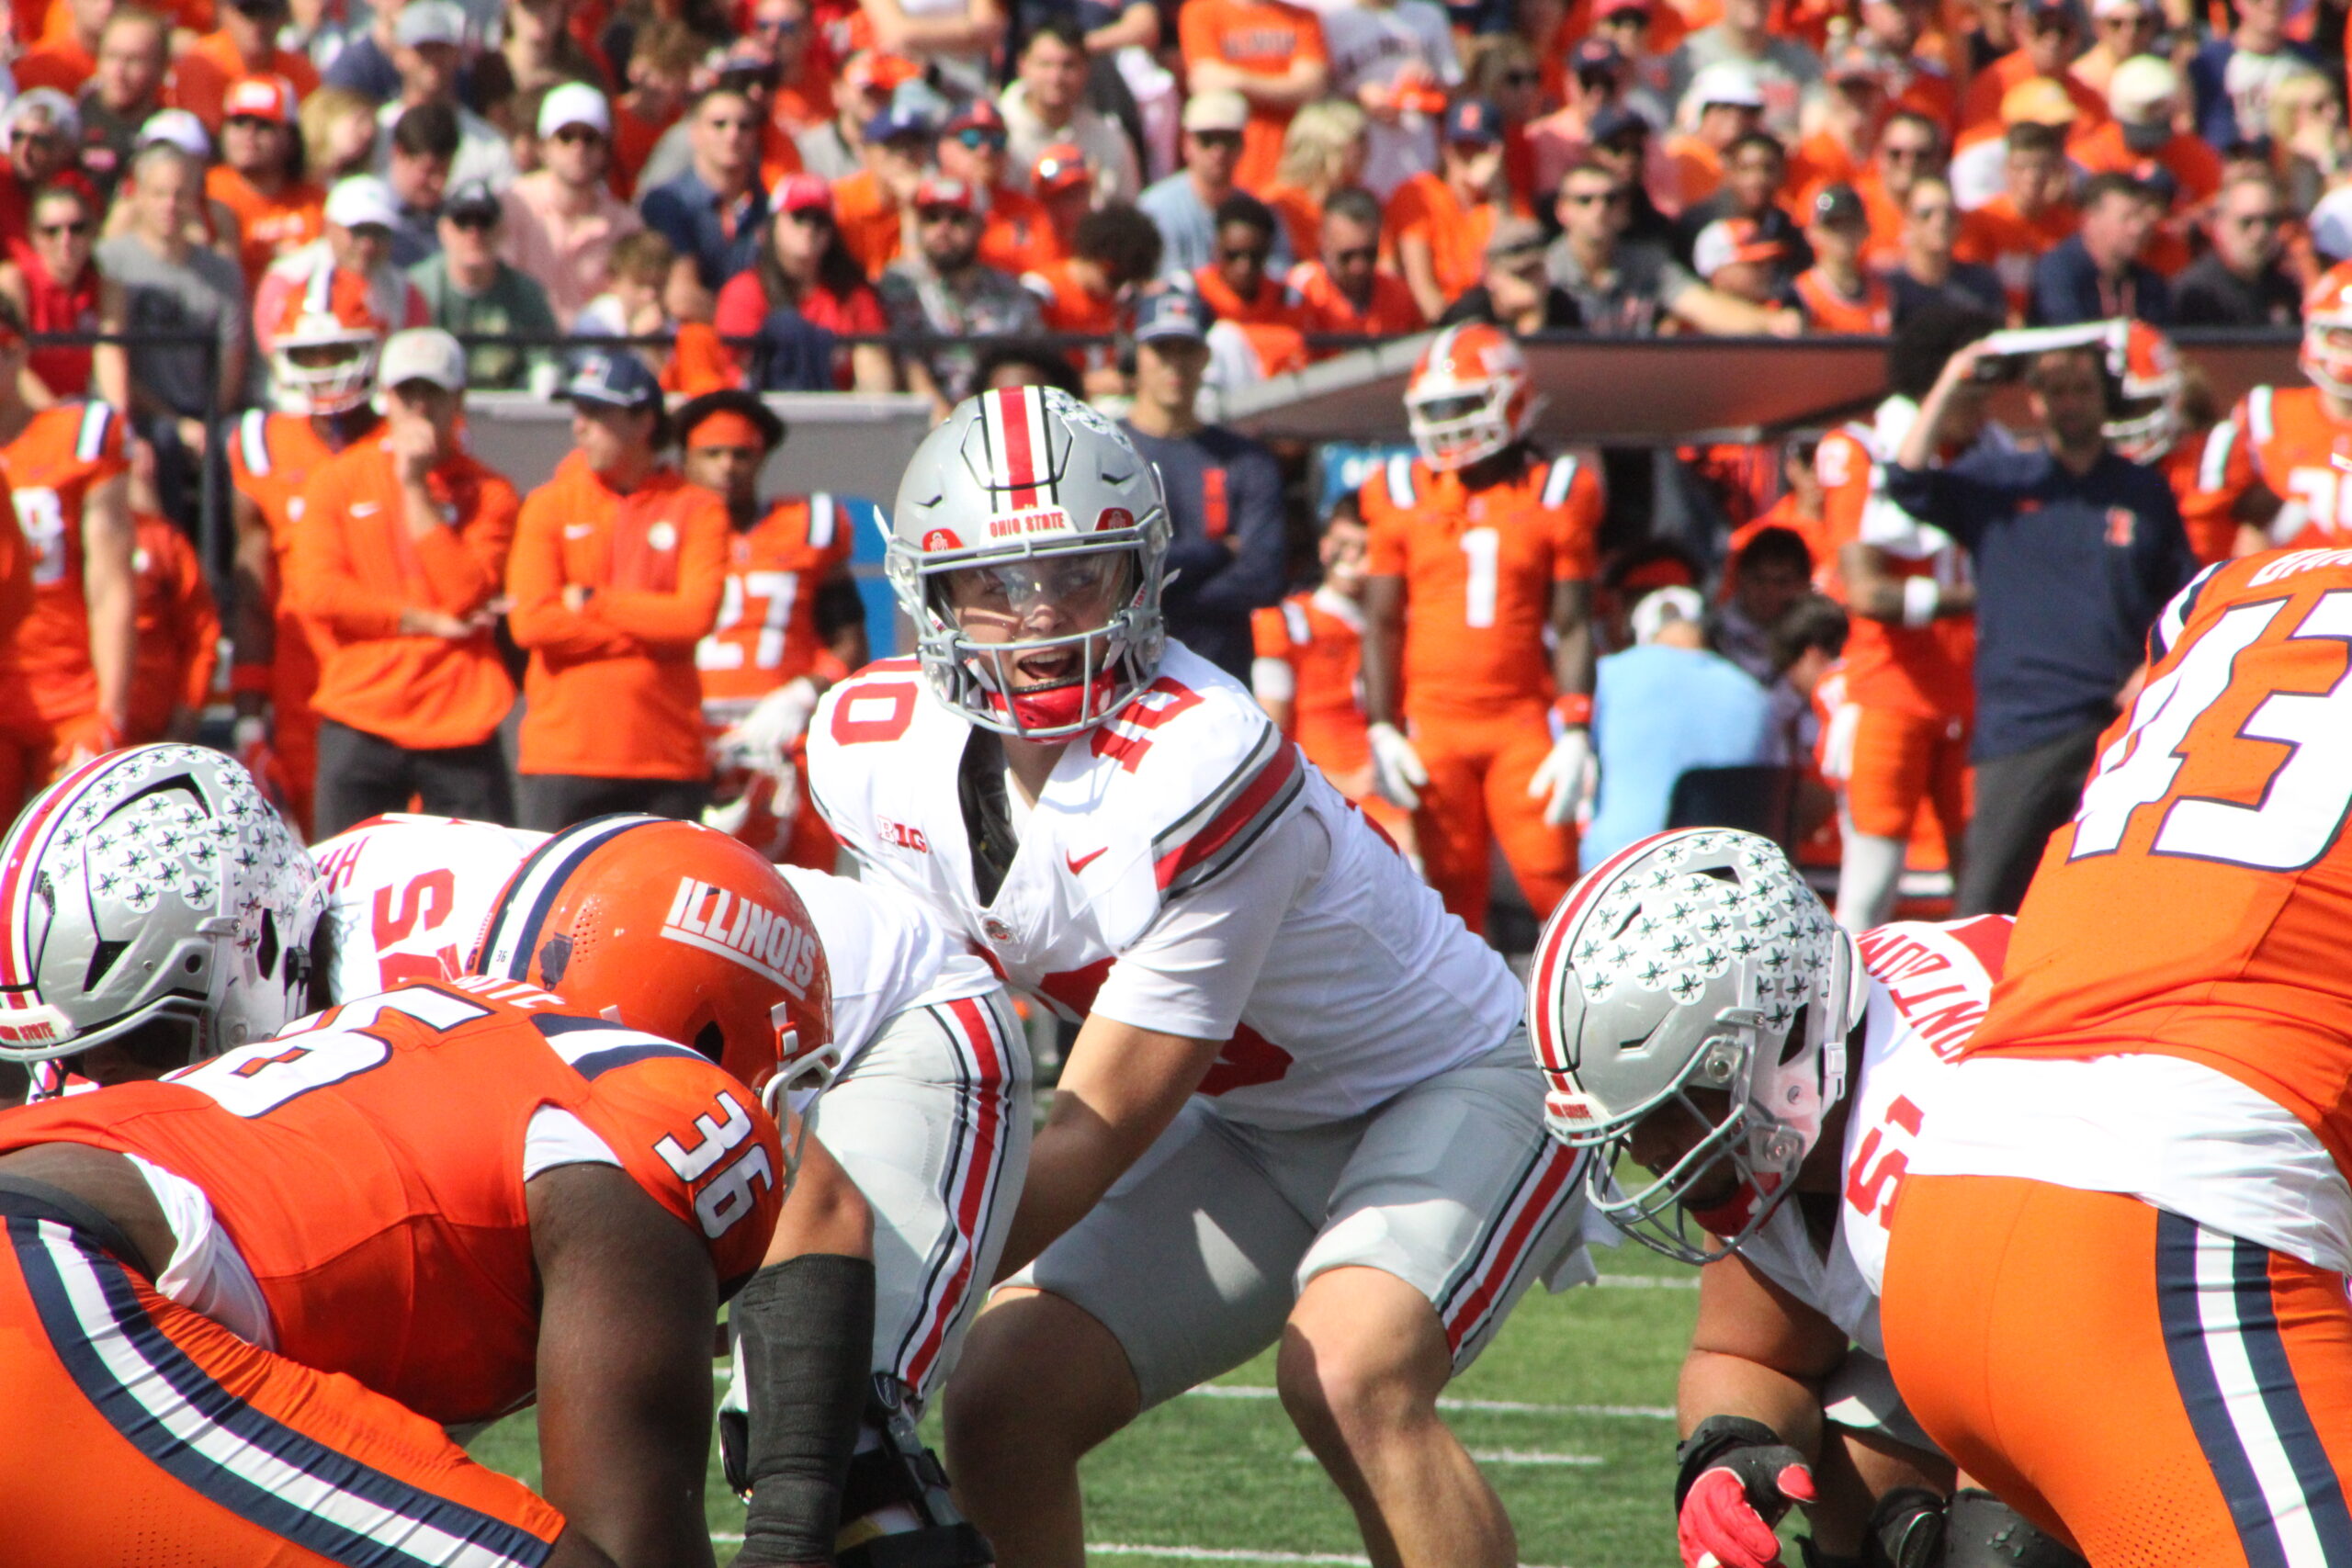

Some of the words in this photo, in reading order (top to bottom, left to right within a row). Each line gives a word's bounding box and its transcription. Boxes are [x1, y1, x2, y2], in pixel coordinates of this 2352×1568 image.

[989, 517, 1021, 537] OHIO
[1024, 512, 1066, 532] STATE
[695, 570, 798, 670] 27
[1459, 526, 1498, 628] 1
[1091, 675, 1206, 775] 10
[496, 950, 508, 964] 36
[664, 876, 816, 987] ILLINOIS
[651, 1089, 774, 1239] 36
